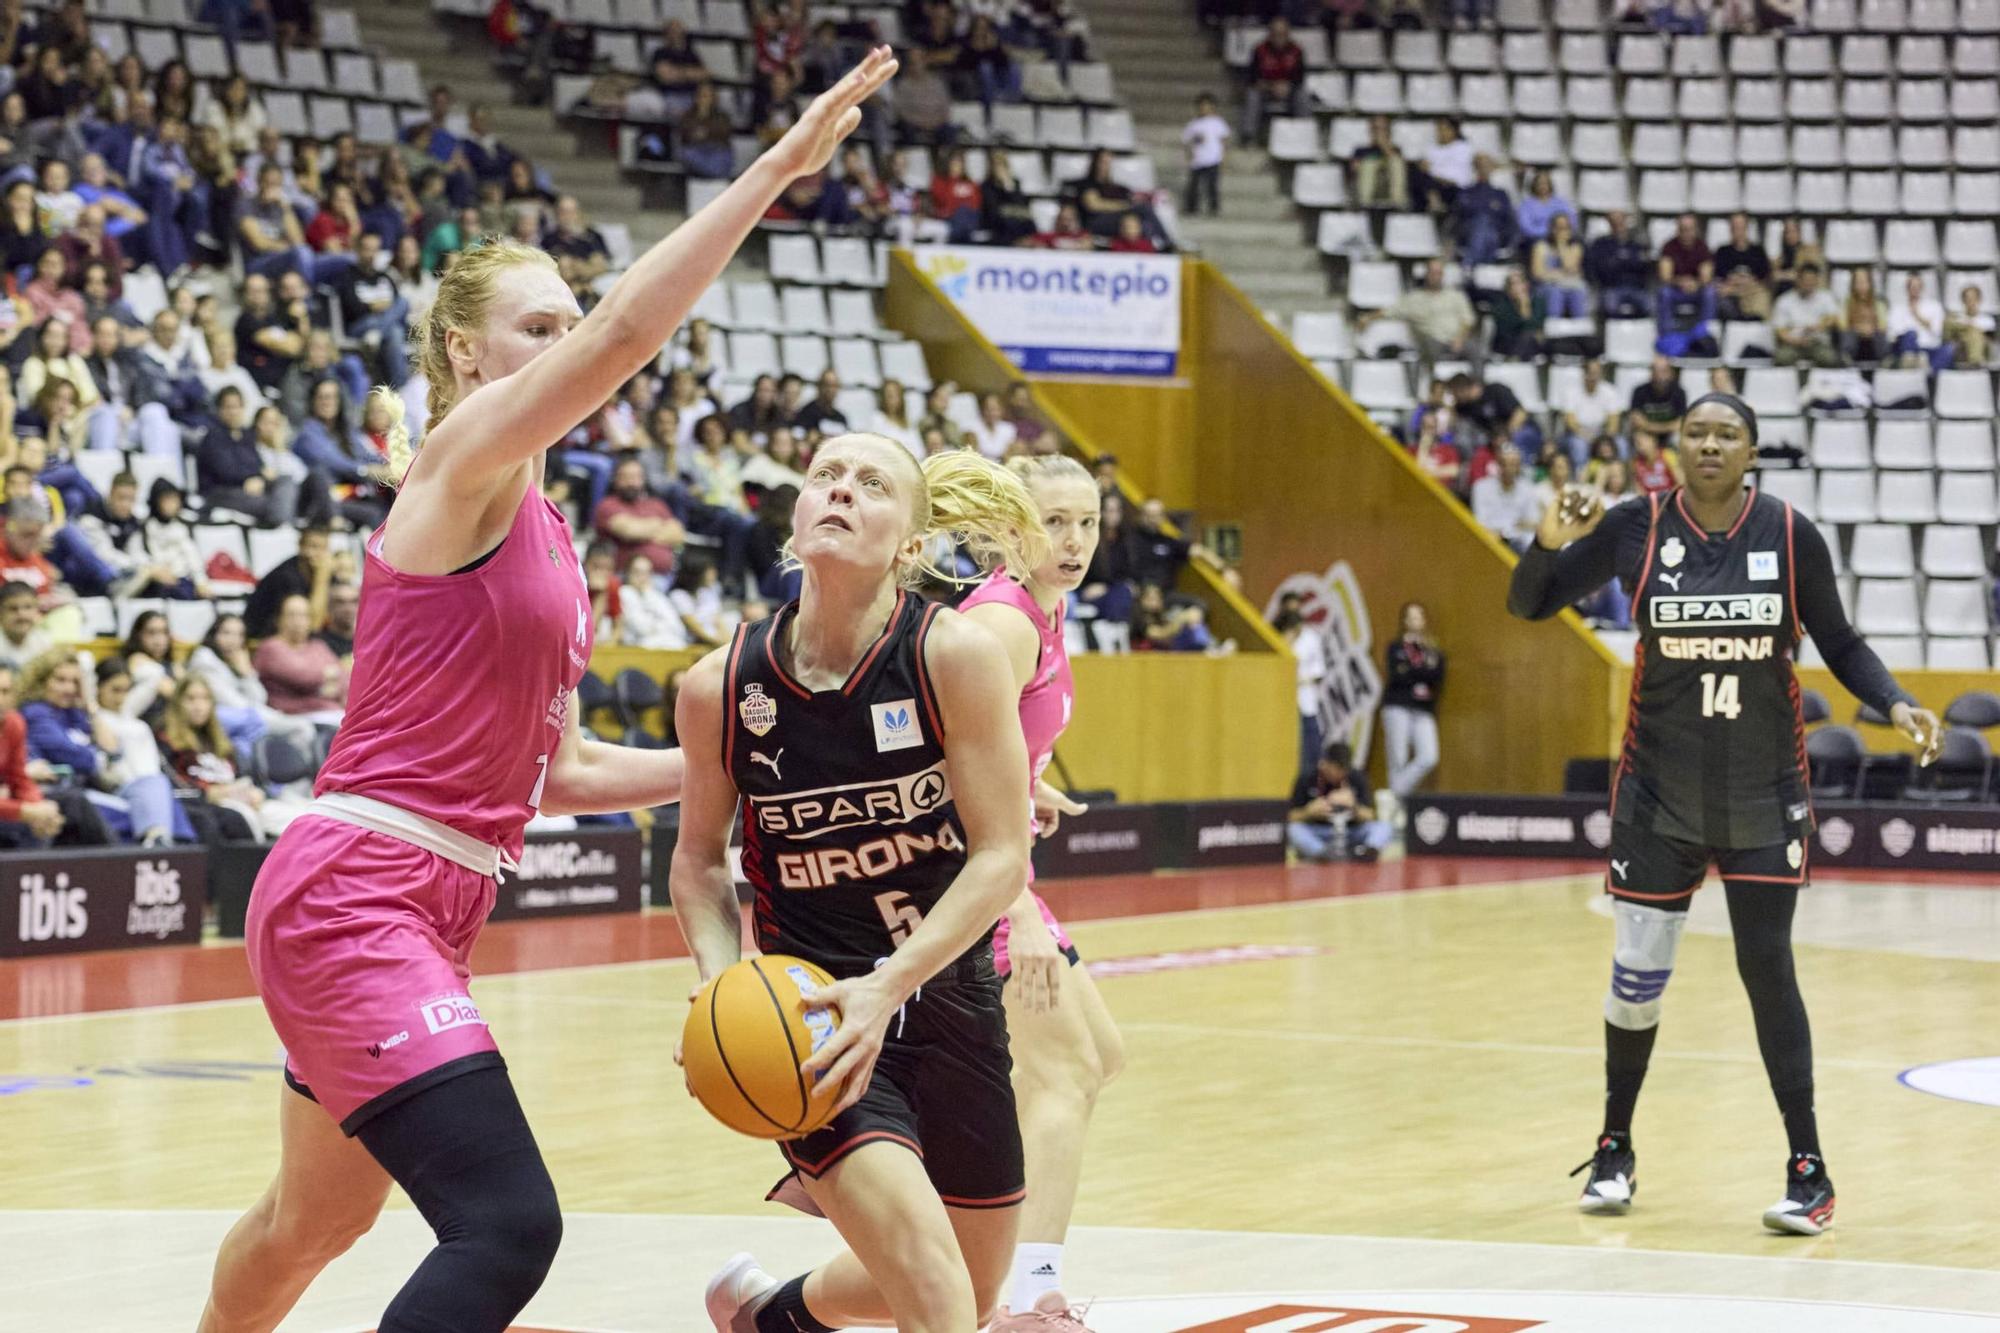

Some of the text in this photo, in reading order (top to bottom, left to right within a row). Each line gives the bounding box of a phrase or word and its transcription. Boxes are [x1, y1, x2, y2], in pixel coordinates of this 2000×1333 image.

[977, 264, 1169, 303] montepio
[1658, 600, 1751, 622] SPAR
[1659, 635, 1774, 661] GIRONA
[745, 683, 763, 693] UNI
[1700, 672, 1742, 719] 14
[744, 714, 776, 726] GIRONA
[761, 791, 900, 830] SPAR
[776, 820, 965, 889] GIRONA
[135, 859, 181, 905] ibis
[19, 872, 88, 942] ibis
[873, 890, 924, 950] 5
